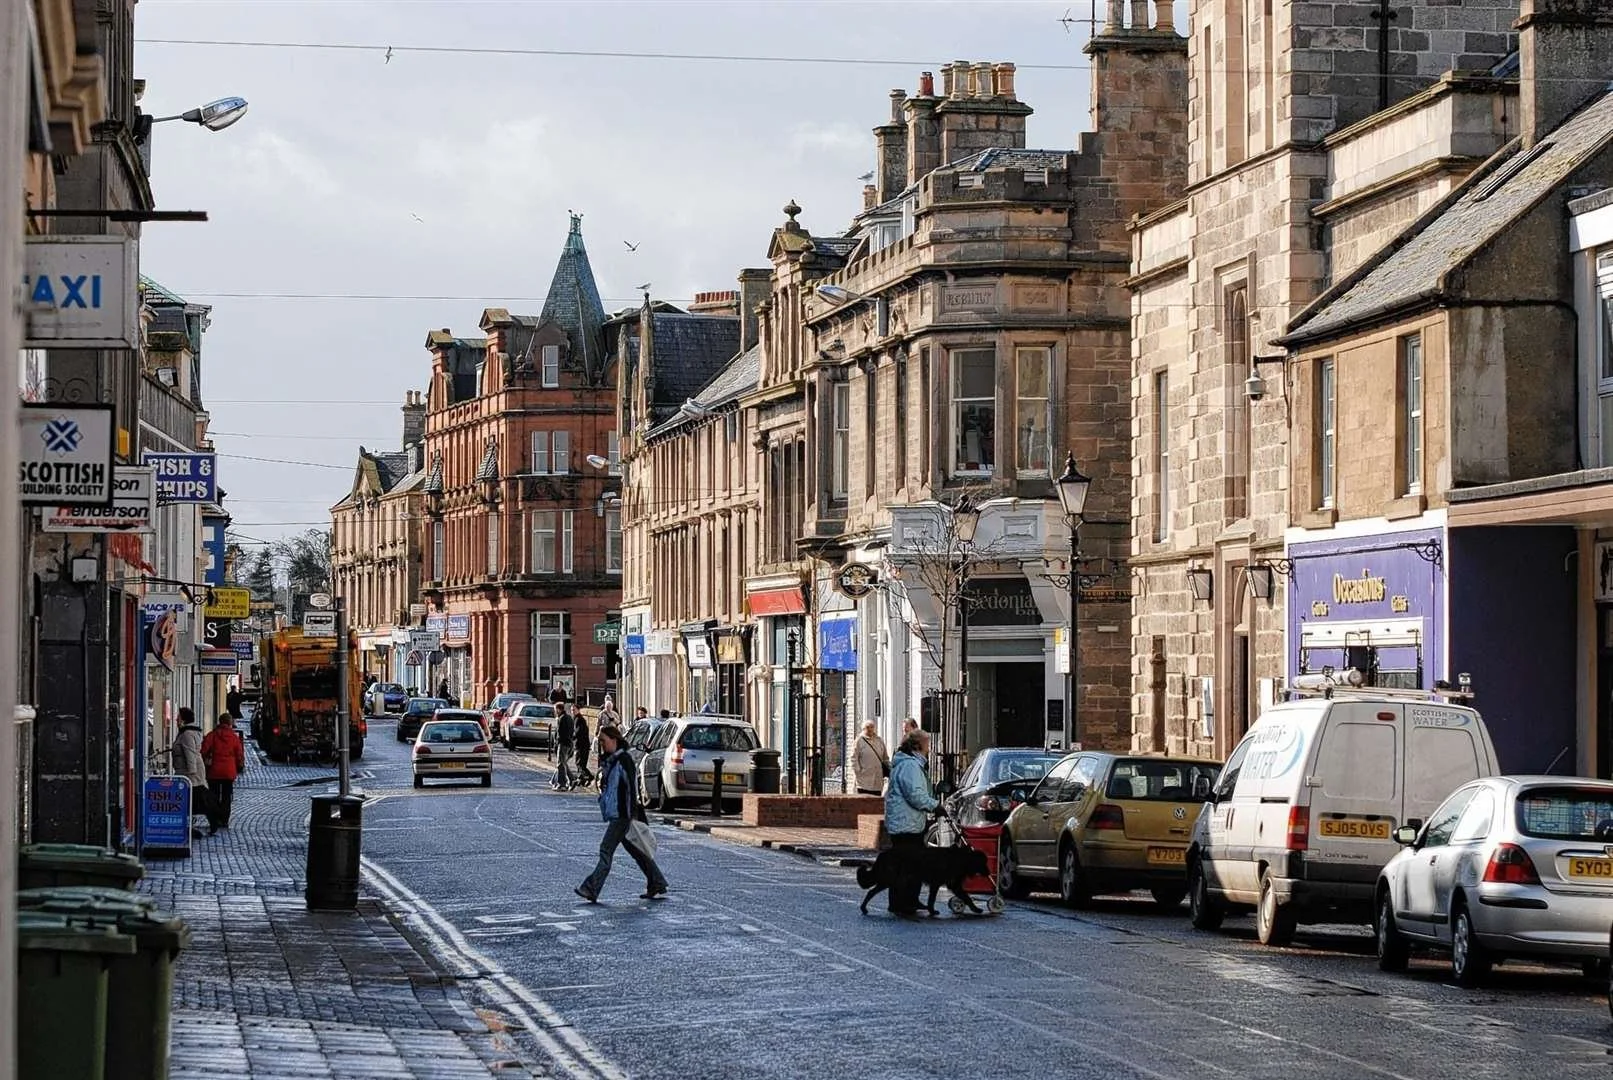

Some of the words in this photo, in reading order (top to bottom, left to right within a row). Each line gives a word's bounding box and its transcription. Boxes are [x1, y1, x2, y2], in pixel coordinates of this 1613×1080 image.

[24, 274, 101, 309] AXI
[20, 462, 104, 484] SCOTTISH
[199, 458, 211, 476] &
[20, 484, 62, 496] UILDING
[65, 485, 104, 497] SOCIETY
[1412, 709, 1447, 717] SCOTTISH
[1413, 717, 1447, 726] WATER
[1361, 823, 1384, 836] OVS
[1575, 860, 1612, 875] SY03
